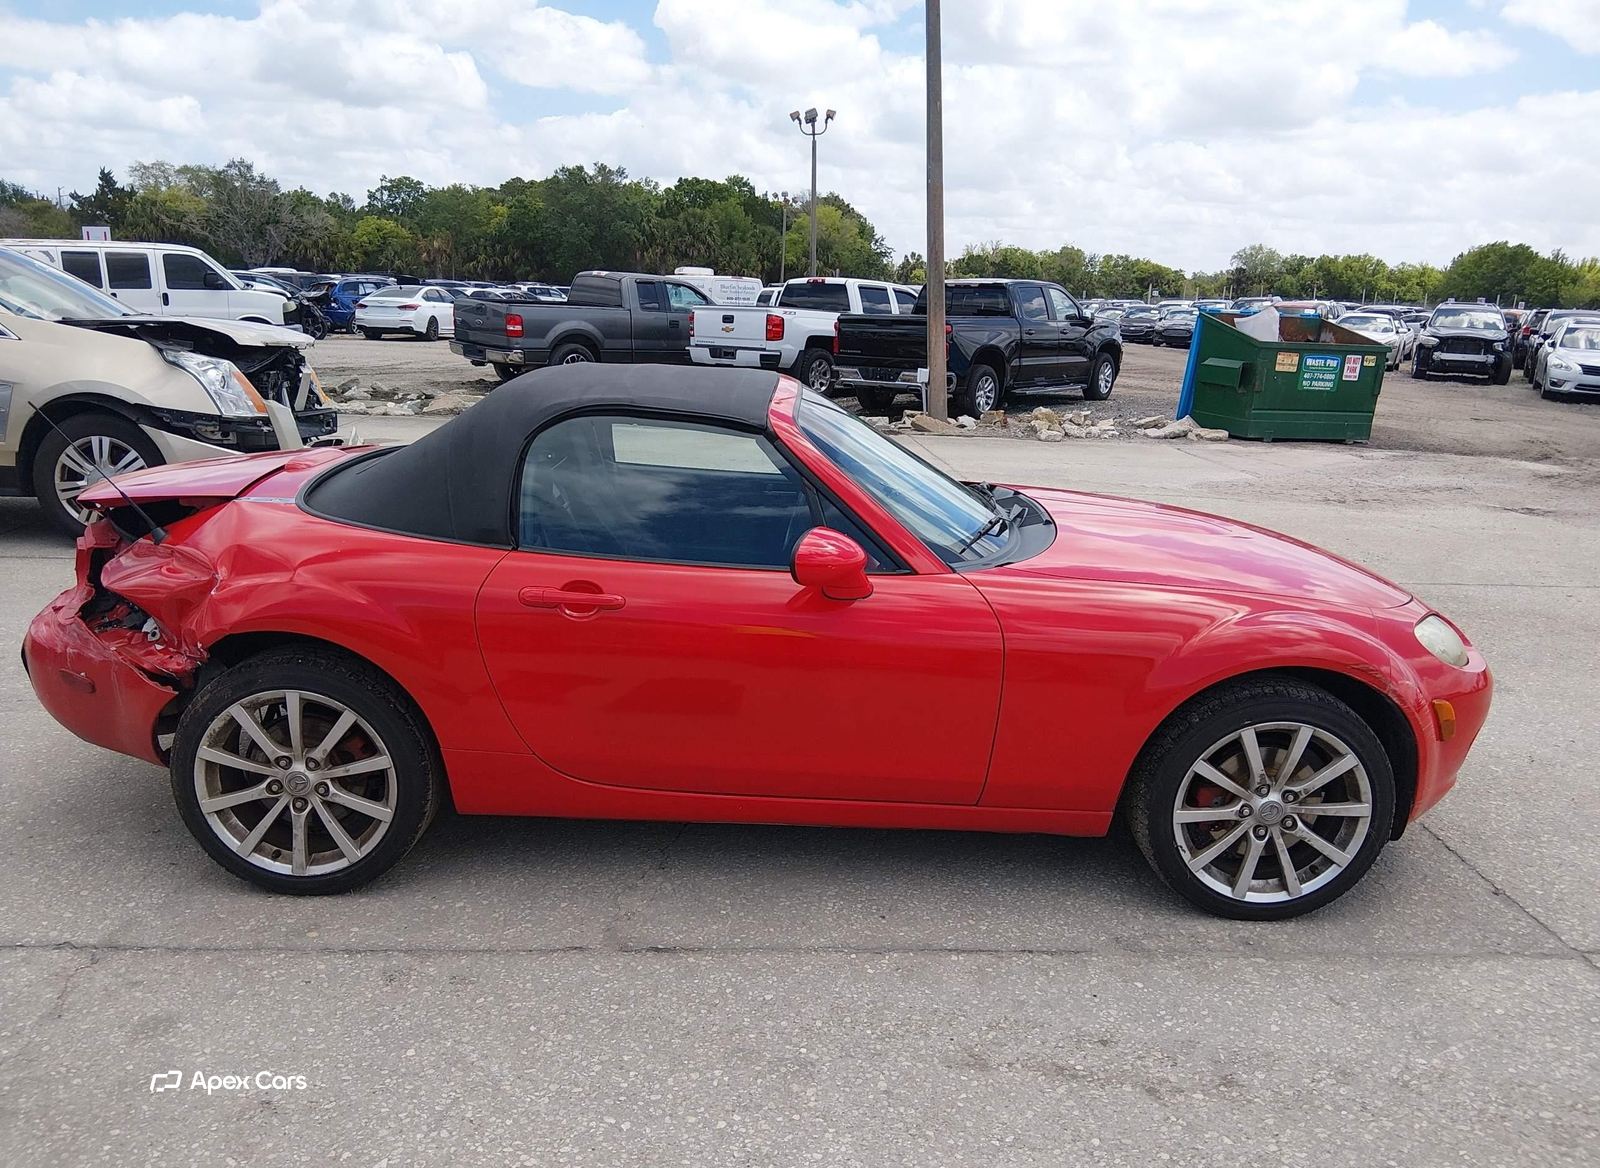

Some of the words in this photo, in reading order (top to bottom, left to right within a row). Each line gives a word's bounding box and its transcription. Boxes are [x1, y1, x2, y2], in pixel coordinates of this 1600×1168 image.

[1306, 358, 1325, 367] WASTE
[1325, 359, 1339, 368] PRO
[1346, 357, 1353, 365] DO
[1353, 357, 1361, 366] NOT
[1346, 365, 1358, 374] PARK
